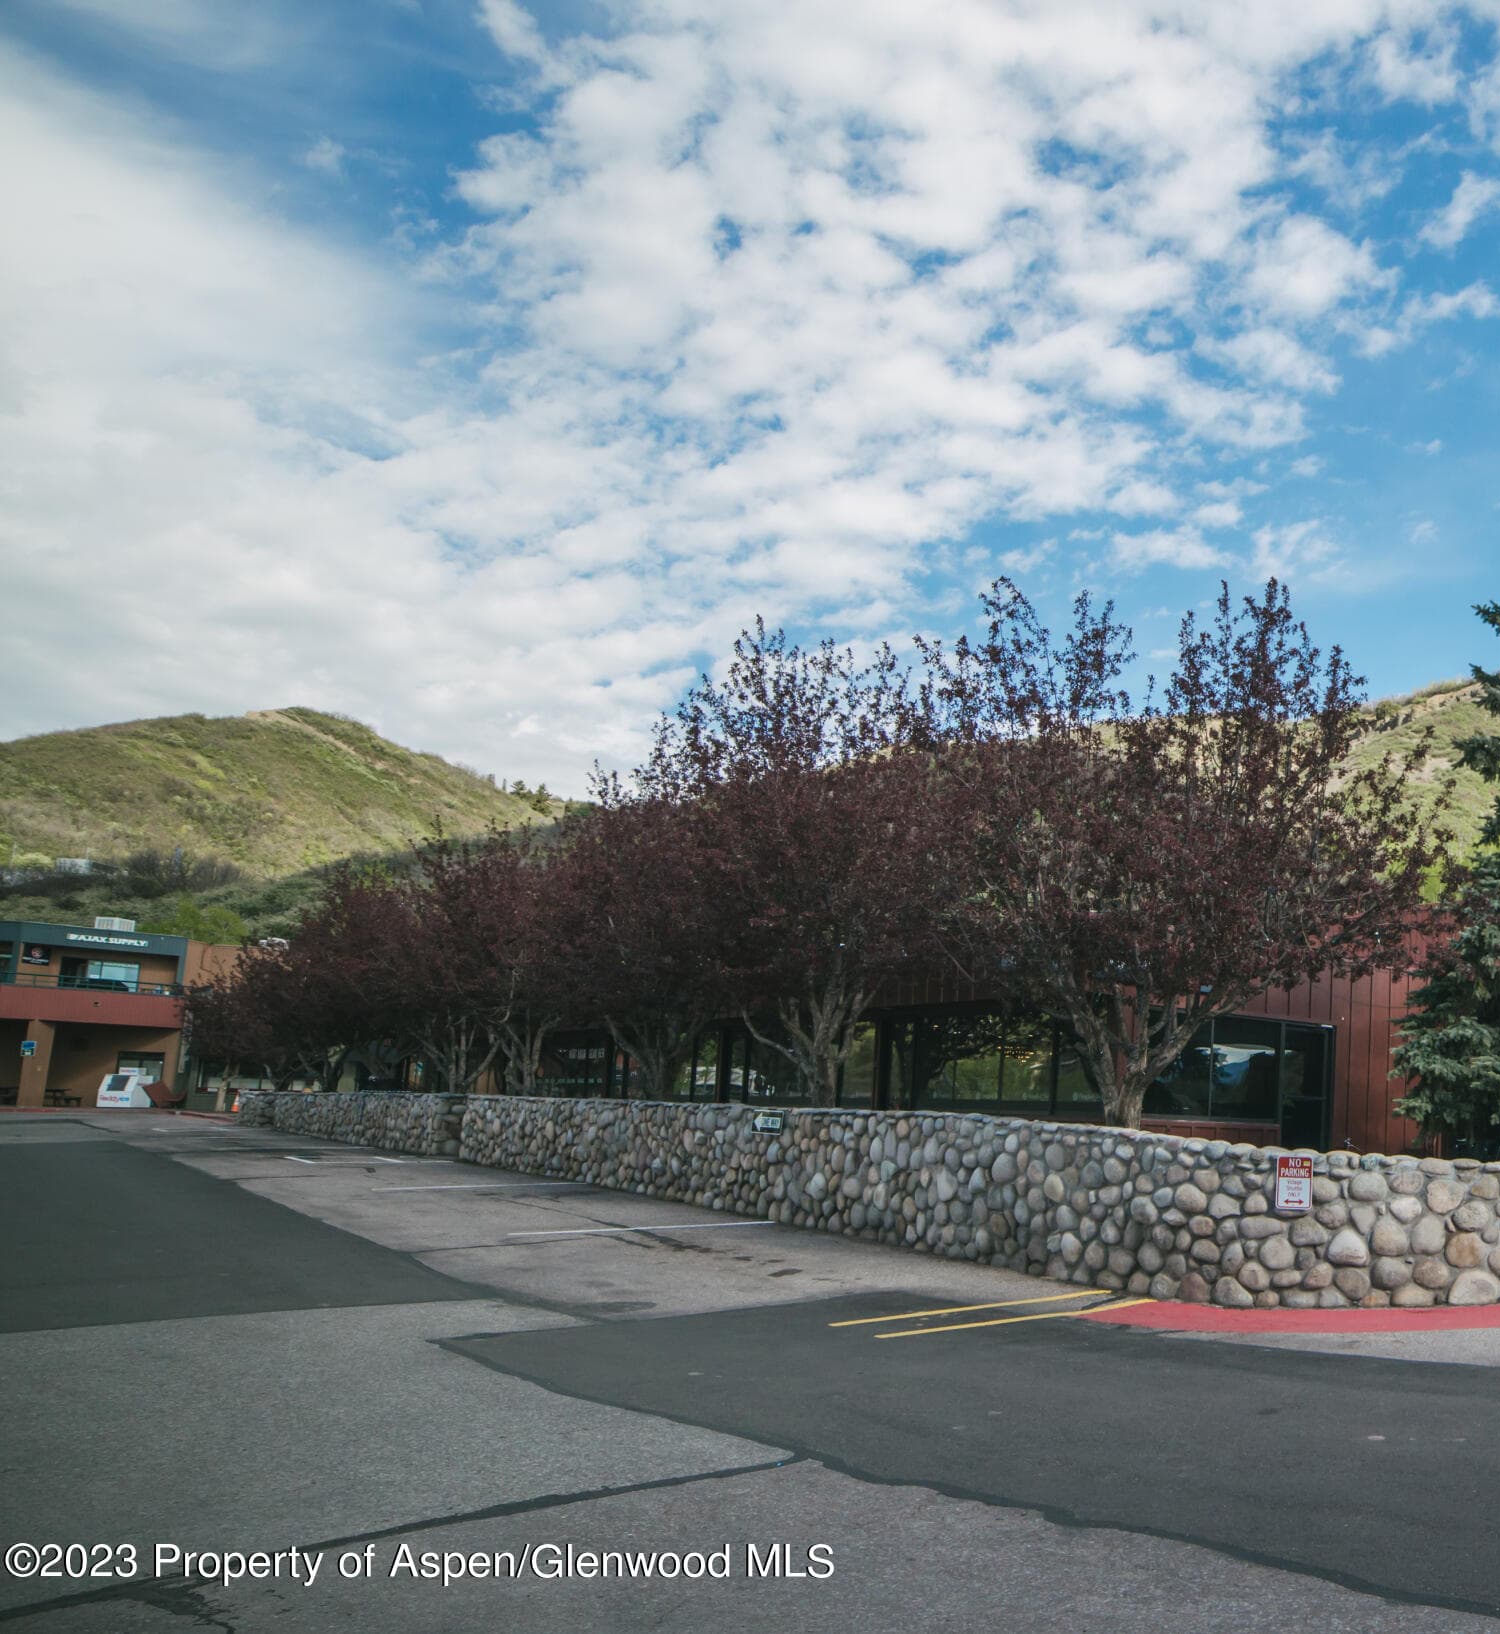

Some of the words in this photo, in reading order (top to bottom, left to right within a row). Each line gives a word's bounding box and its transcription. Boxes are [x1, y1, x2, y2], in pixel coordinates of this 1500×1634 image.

[79, 934, 108, 943] AJAX
[108, 937, 147, 947] SUPPLY
[1288, 1158, 1302, 1168] NO
[1280, 1167, 1310, 1178] PARKING
